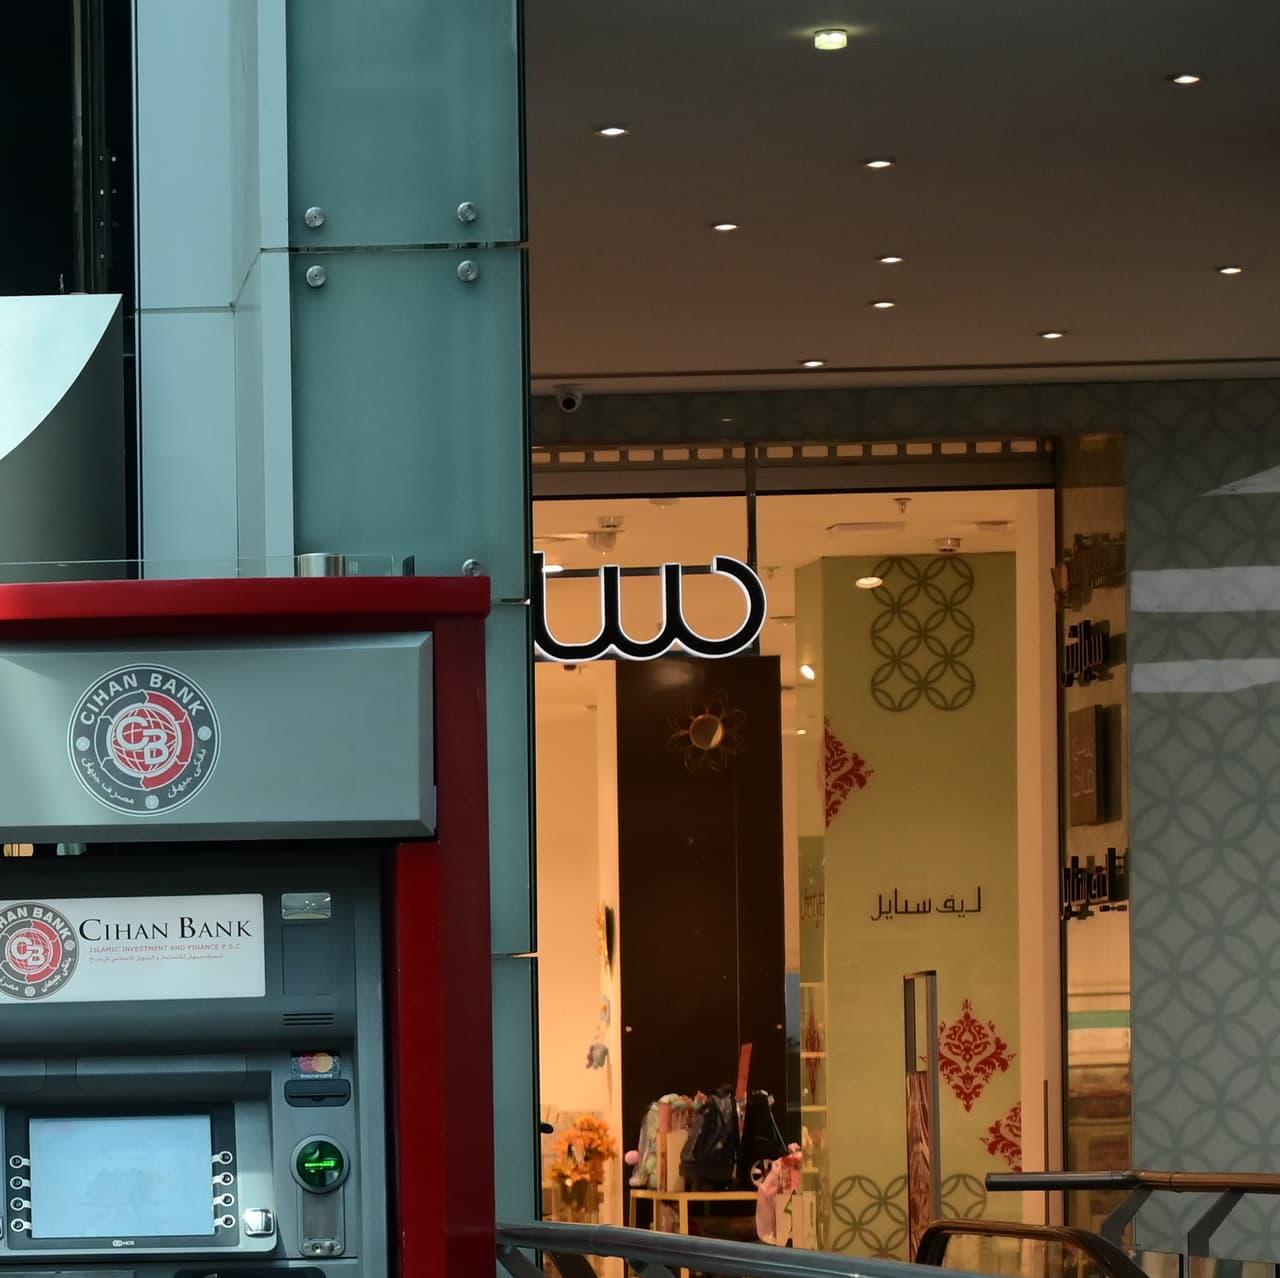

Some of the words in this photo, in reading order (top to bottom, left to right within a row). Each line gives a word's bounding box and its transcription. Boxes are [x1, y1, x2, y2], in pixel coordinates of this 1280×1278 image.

[80, 673, 138, 725] CIHAN
[149, 673, 205, 716] BANK
[32, 907, 72, 940] BANK
